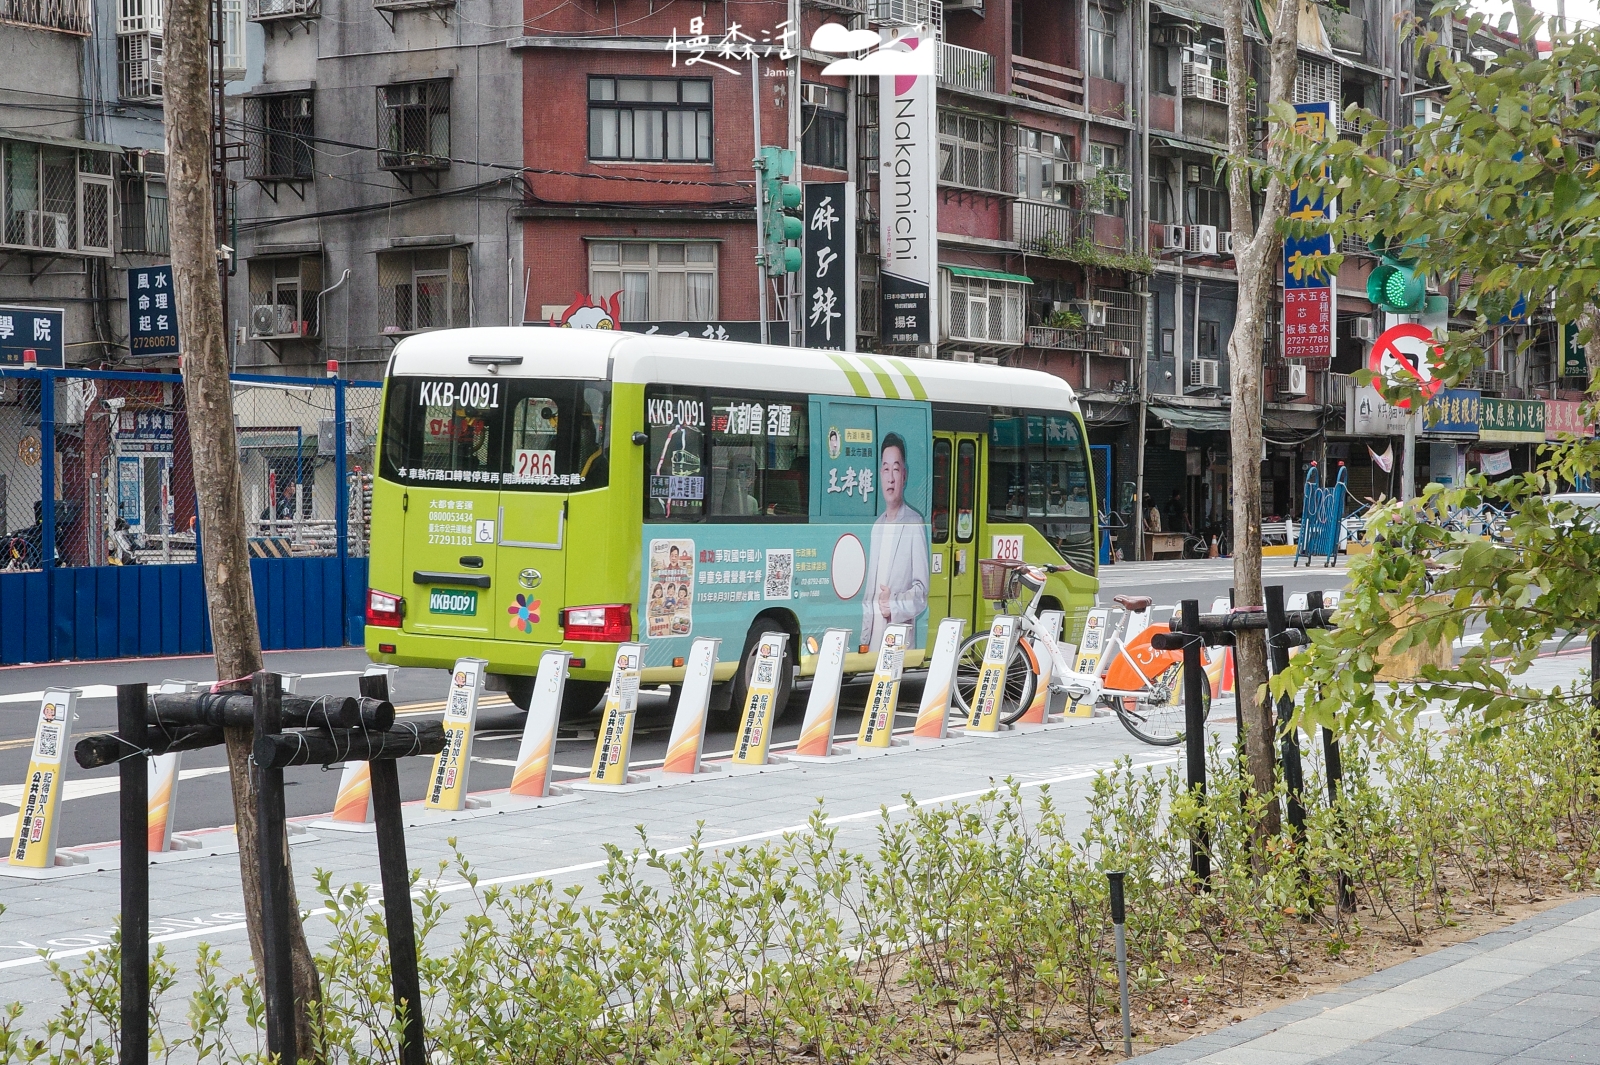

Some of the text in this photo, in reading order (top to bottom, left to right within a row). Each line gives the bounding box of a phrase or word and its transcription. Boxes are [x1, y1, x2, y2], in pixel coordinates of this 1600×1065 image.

[894, 98, 920, 262] Nakamichi
[895, 315, 917, 329] 揚名
[134, 336, 176, 348] 27260678
[1287, 335, 1329, 345] 2727-7788
[1287, 345, 1329, 355] 2727-3377
[419, 381, 499, 408] KKB-0091
[648, 398, 706, 427] KKB-0091
[518, 453, 552, 478] 286
[429, 500, 473, 510] 大都會客運
[428, 512, 473, 522] 0800053434
[428, 534, 473, 546] 27291181
[997, 538, 1019, 560] 286
[430, 593, 475, 612] KKB-0091
